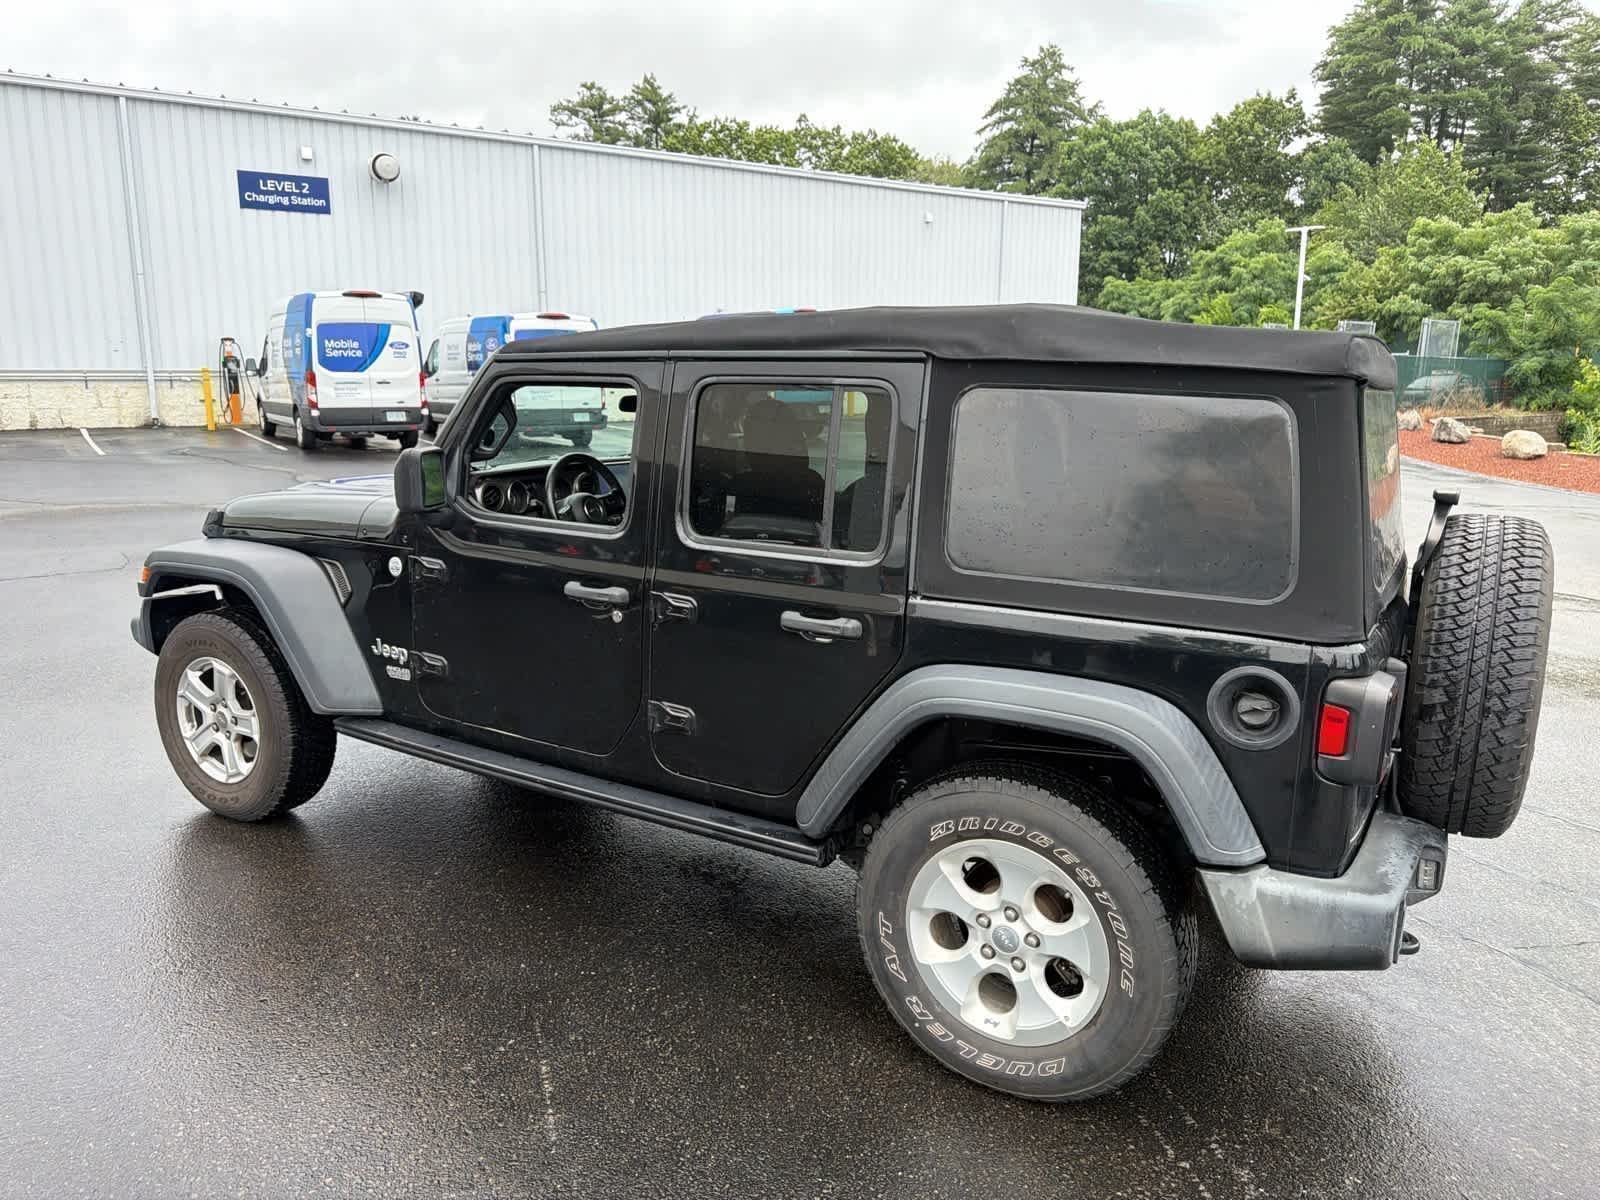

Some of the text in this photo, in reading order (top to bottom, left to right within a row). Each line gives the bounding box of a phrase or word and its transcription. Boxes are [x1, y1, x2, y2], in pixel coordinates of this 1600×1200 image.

[259, 179, 310, 194] LEVEL 2
[244, 191, 326, 207] Charging Station
[324, 339, 360, 349] Mobile
[325, 348, 363, 358] Service
[371, 638, 408, 665] Jeep
[930, 816, 1135, 998] BRIDGESTONE
[879, 911, 1066, 1077] DUELER A/T
